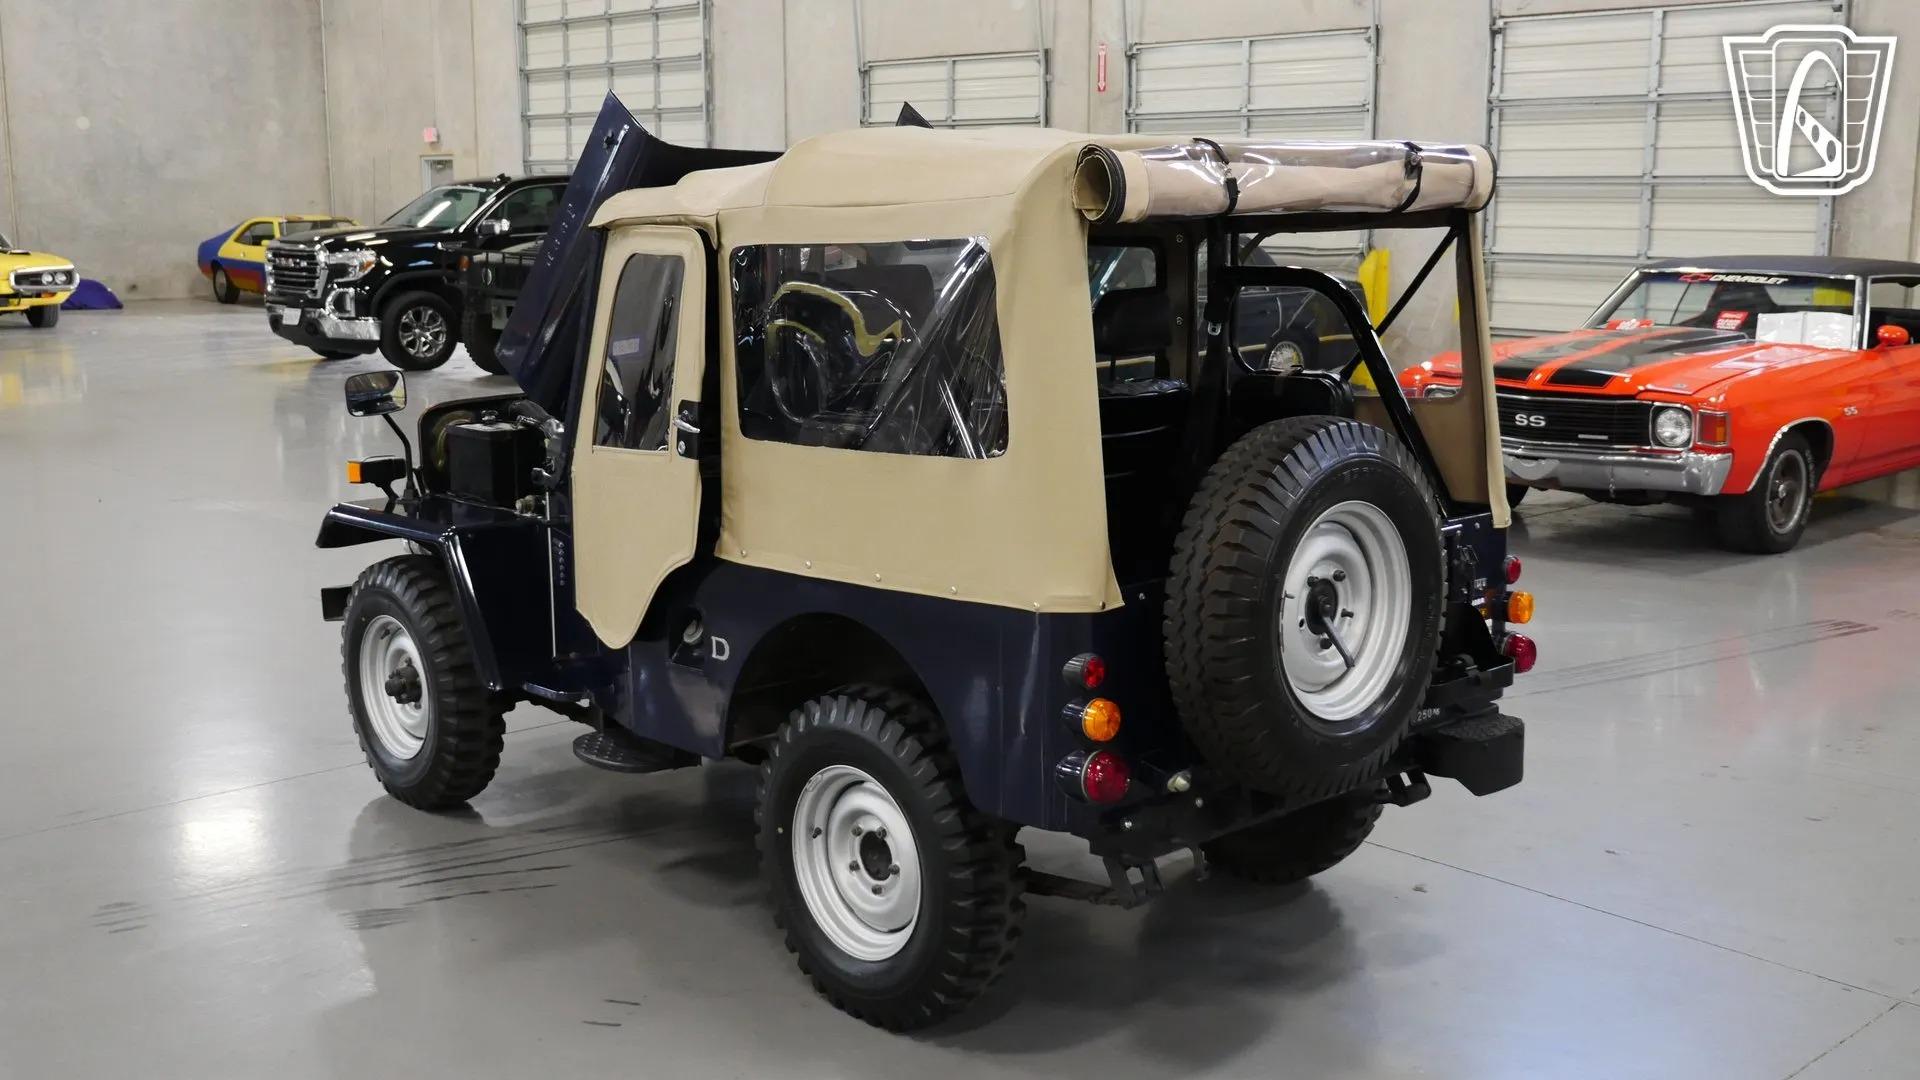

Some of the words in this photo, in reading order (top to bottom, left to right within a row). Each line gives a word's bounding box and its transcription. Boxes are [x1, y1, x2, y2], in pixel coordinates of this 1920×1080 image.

[1709, 274, 1789, 285] CHEVROLET
[1515, 413, 1546, 427] SS
[711, 635, 730, 661] D
